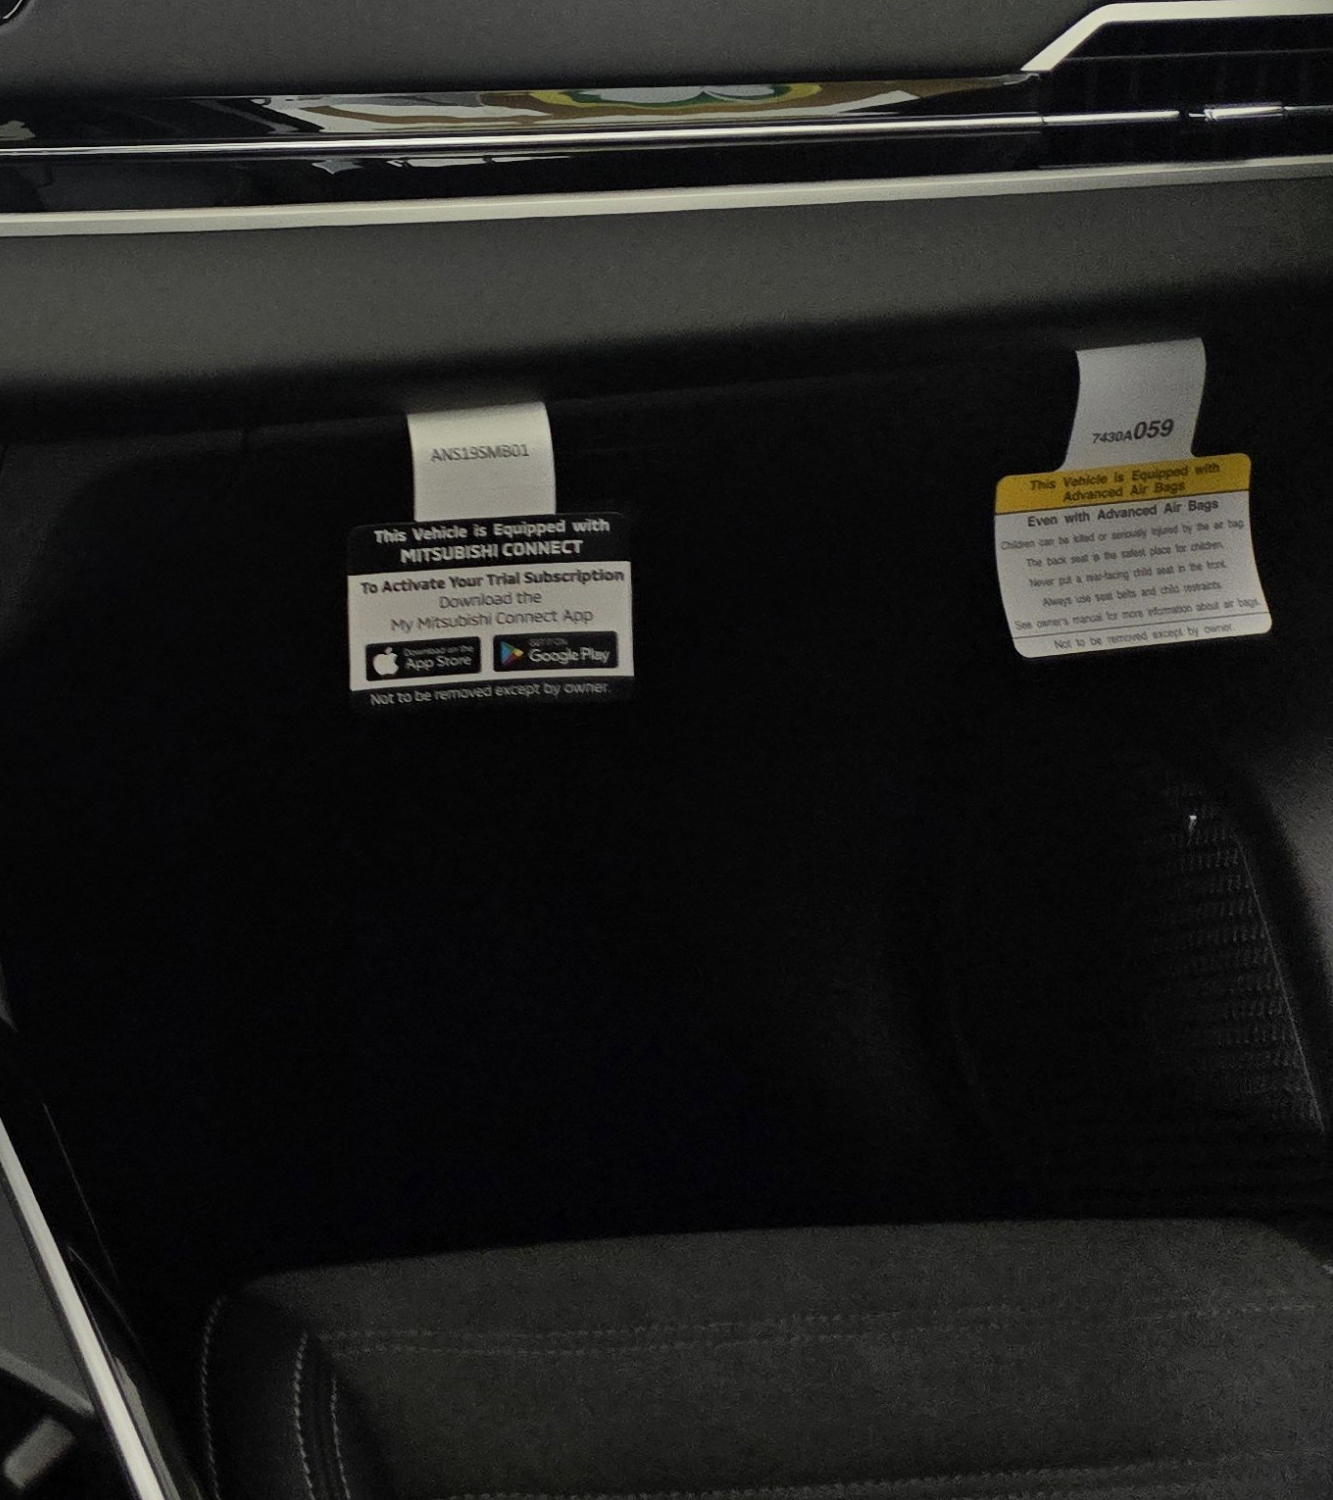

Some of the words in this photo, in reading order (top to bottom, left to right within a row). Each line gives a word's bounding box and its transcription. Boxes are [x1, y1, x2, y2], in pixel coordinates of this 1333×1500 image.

[1092, 418, 1175, 444] 7430A059
[1030, 479, 1056, 491] This
[1063, 474, 1108, 488] Vehicle
[1114, 471, 1124, 483] is
[1131, 465, 1189, 483] Equipped
[1195, 462, 1221, 476] with
[1062, 487, 1123, 502] Advanced
[1130, 484, 1149, 496] Air
[1154, 481, 1186, 494] Bags
[1027, 516, 1059, 527] Even
[1064, 511, 1091, 523] with
[1097, 504, 1158, 520] Advanced
[1164, 502, 1183, 514] Air
[1188, 500, 1219, 513] Bags
[374, 528, 407, 543] This
[412, 524, 468, 541] Vehicle
[473, 523, 488, 537] is
[493, 520, 566, 538] Equipped
[571, 518, 610, 532] with
[400, 543, 499, 564] MITSUBISHI
[501, 539, 584, 557] CONNECT
[360, 581, 379, 594] To
[382, 578, 446, 593] Activate
[449, 575, 484, 588] Your
[486, 571, 521, 586] Trial
[524, 569, 625, 585] Subscription
[439, 591, 513, 609] Download
[516, 592, 542, 605] the
[391, 618, 415, 634] My
[417, 612, 492, 629] Mitsubishi
[496, 610, 558, 625] Connect
[563, 609, 594, 625] App
[405, 657, 434, 672] App
[435, 655, 473, 668] Store
[528, 647, 580, 665] Google
[580, 646, 610, 663] Play
[370, 692, 395, 705] Not
[396, 691, 412, 703] to
[414, 689, 432, 702] be
[434, 685, 492, 701] removed
[494, 683, 541, 698] except
[543, 682, 561, 699] by
